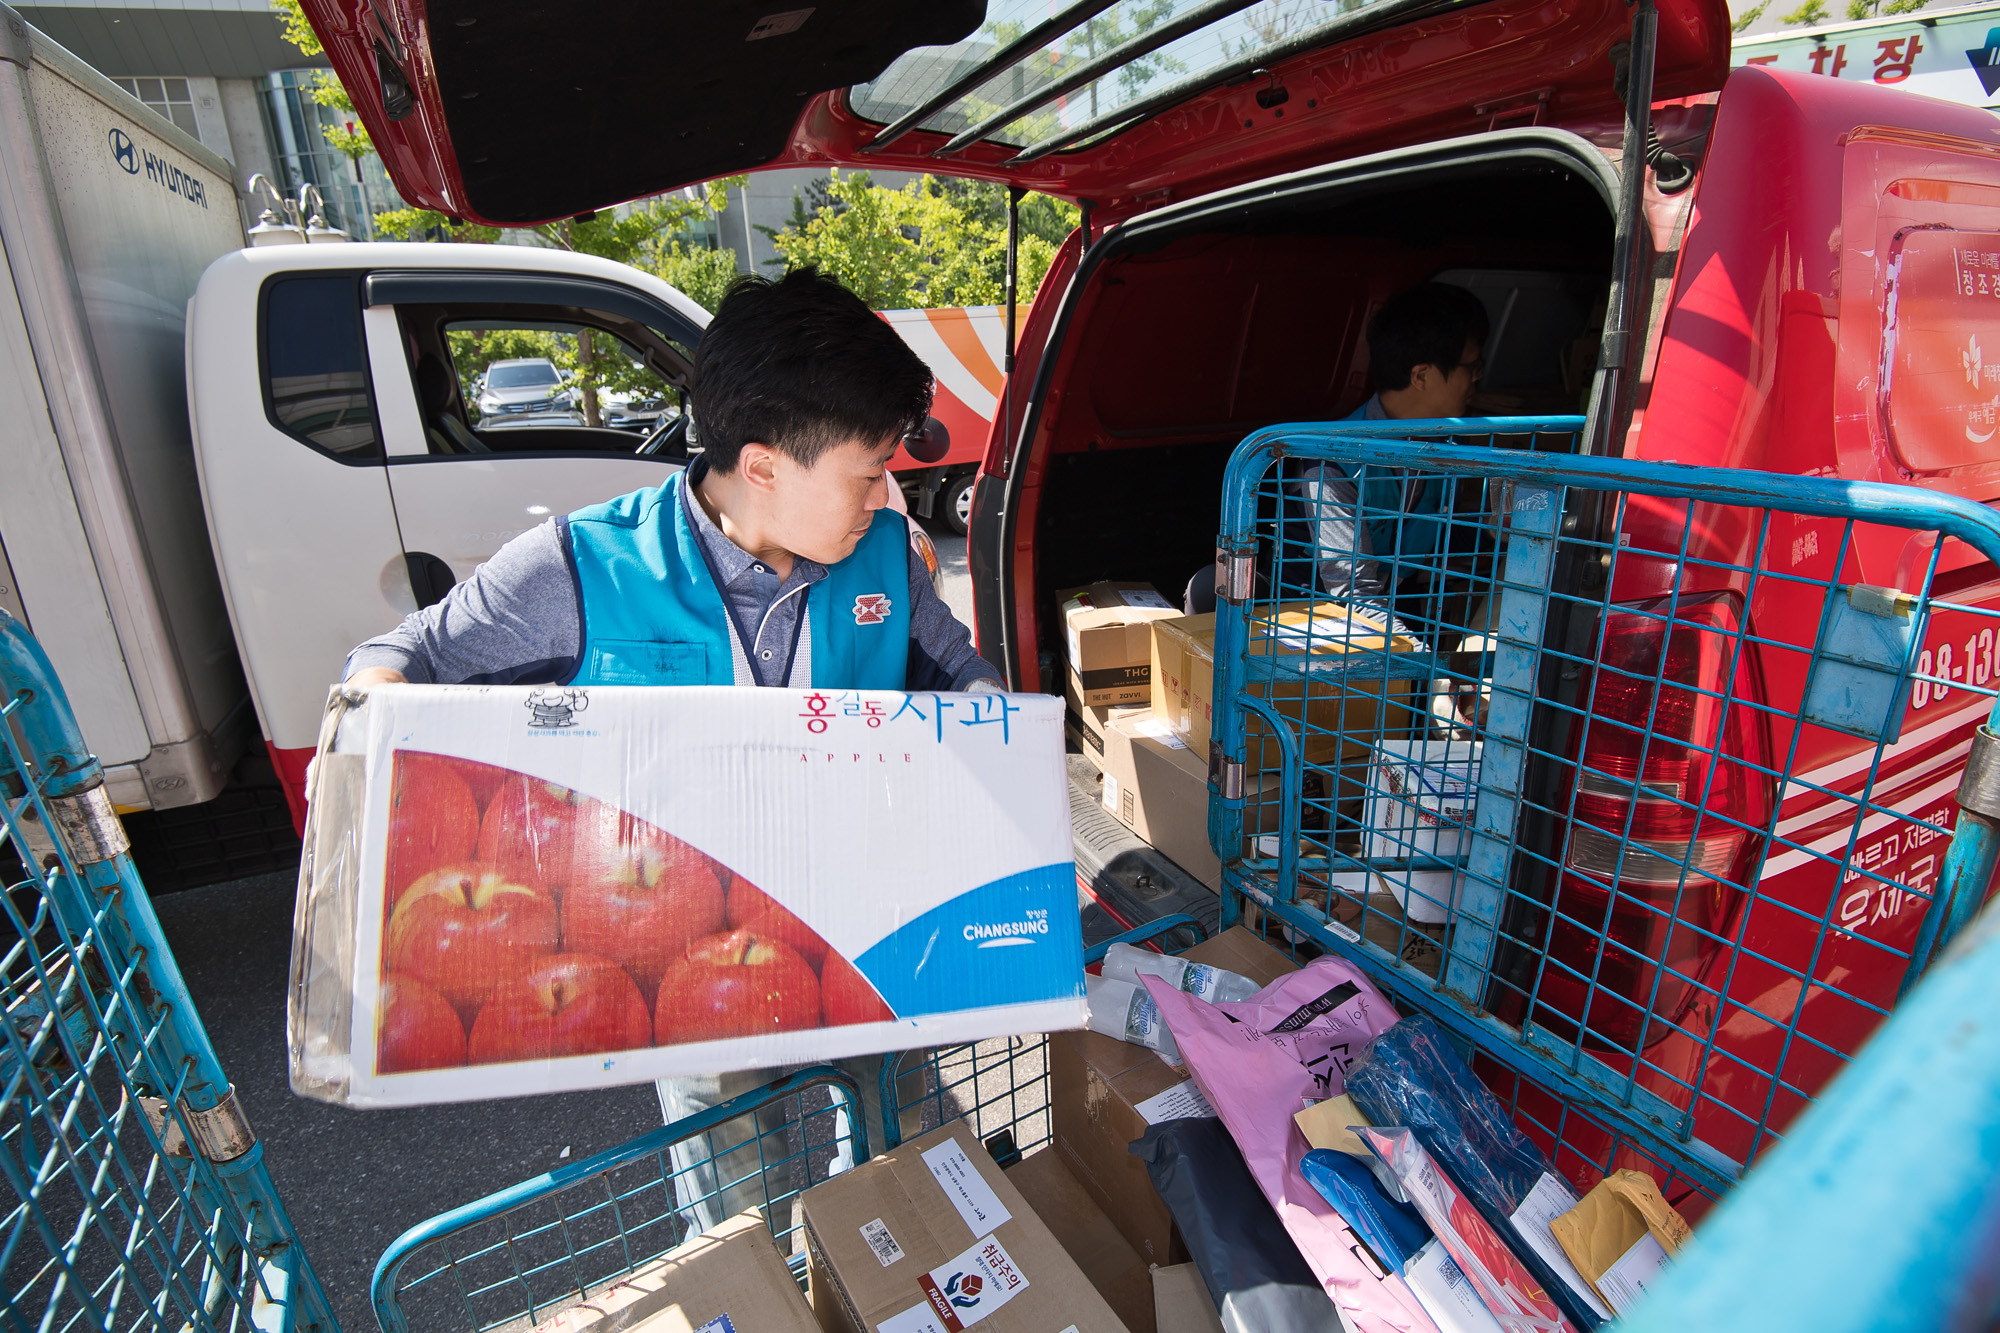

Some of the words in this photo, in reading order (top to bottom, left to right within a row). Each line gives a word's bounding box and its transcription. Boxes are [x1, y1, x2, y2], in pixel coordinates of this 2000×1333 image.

[142, 148, 208, 209] HYUNDAI
[1960, 249, 1981, 268] 새로운
[1124, 667, 1149, 677] THG
[1843, 834, 1900, 884] 빠르고
[1902, 807, 1950, 855] 저렴한
[1835, 854, 1935, 940] 우체국
[963, 918, 1049, 941] CHANGSUNG
[982, 1243, 1021, 1290] 취급주의
[928, 1288, 953, 1319] FRAGILE
